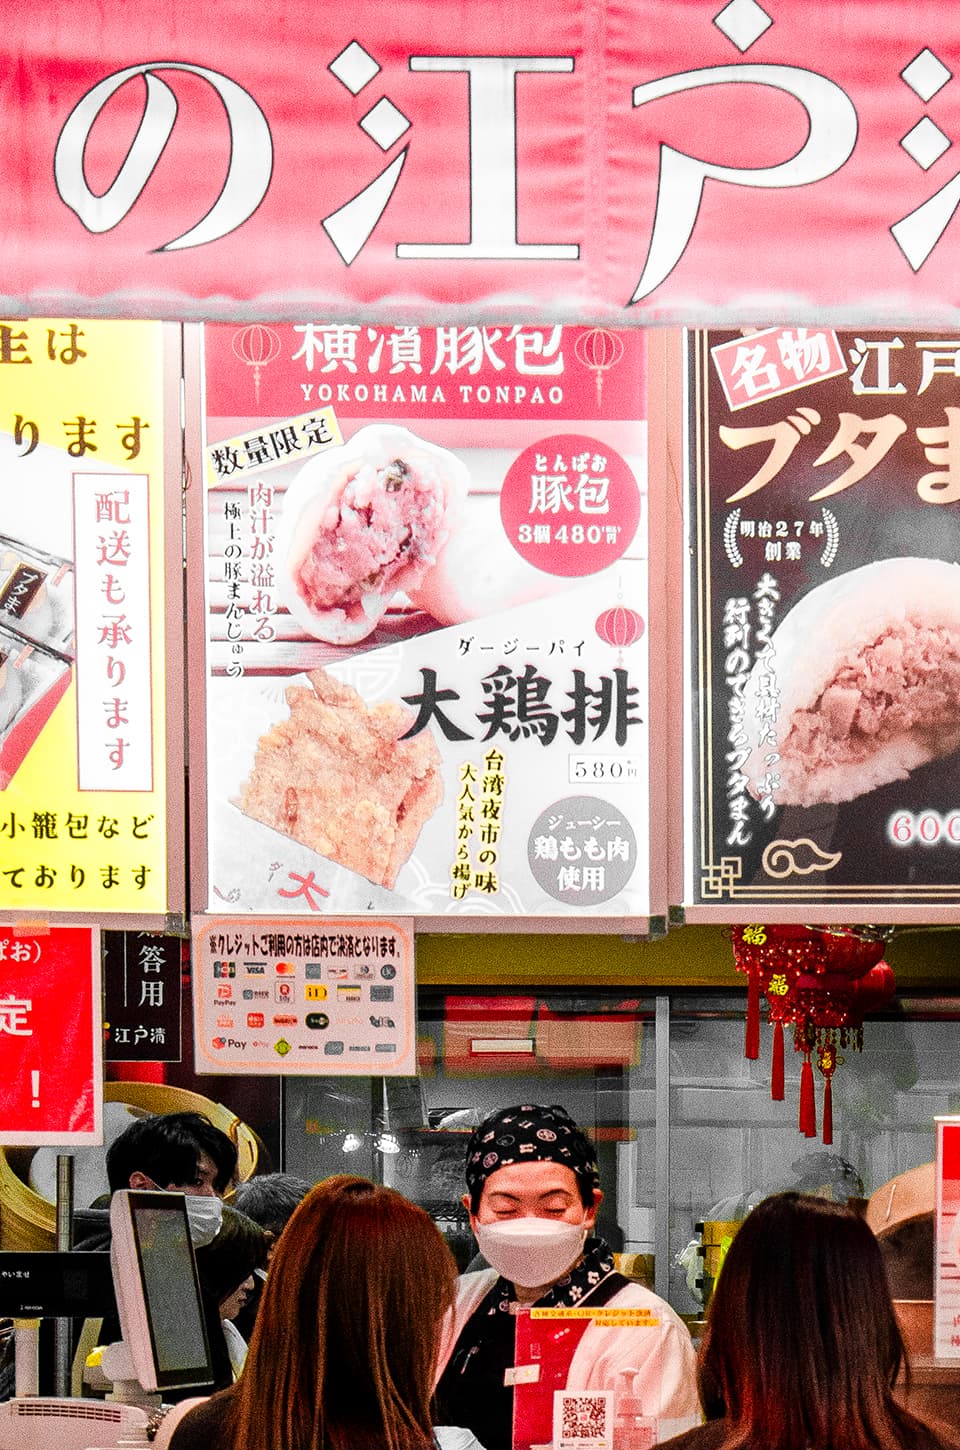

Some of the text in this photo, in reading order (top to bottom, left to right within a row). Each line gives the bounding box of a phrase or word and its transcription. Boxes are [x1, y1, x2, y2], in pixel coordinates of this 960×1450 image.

[732, 327, 831, 398] 名物
[301, 384, 564, 404] YOKOHAMA TONPAO
[210, 417, 334, 478] 数量限定
[528, 475, 610, 515] 豚包
[248, 484, 276, 641] 肉汁が溢れる
[765, 541, 803, 562] 創業
[223, 501, 244, 678] 極上の豚まんじゅう
[95, 489, 134, 771] 配送も承ります
[458, 637, 587, 657] ダージーパイ
[397, 664, 644, 747] 大鶏排
[753, 573, 781, 821] 大きくて具材たっぷり
[452, 763, 478, 899] 大人気から揚げ
[474, 748, 505, 894] 台湾夜市の味
[547, 815, 622, 831] ジューシー
[533, 836, 630, 862] 鶏もも肉
[2, 865, 152, 890] ております
[557, 866, 606, 892] 使用
[114, 1026, 166, 1046] 江戸清
